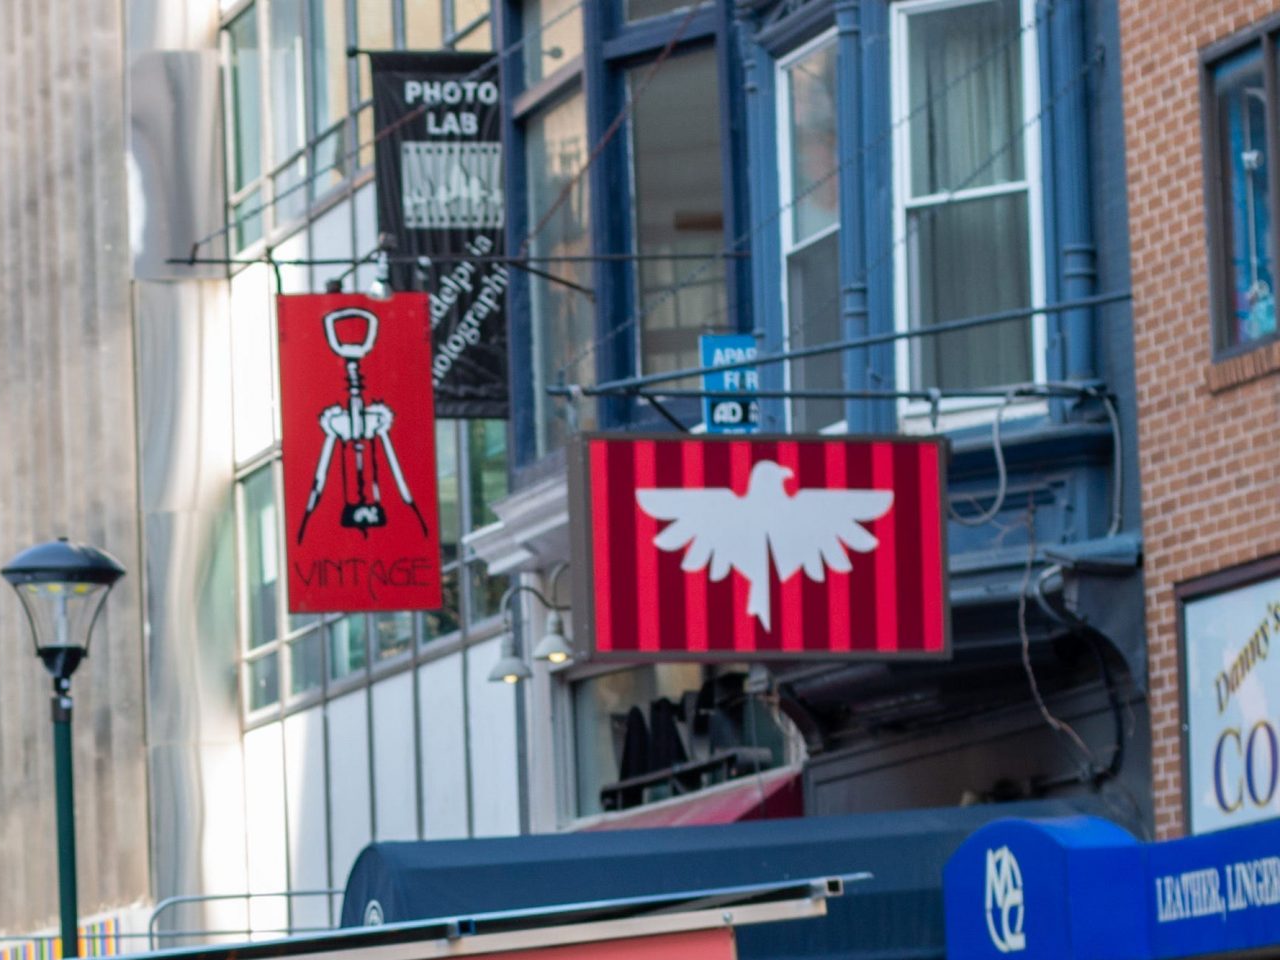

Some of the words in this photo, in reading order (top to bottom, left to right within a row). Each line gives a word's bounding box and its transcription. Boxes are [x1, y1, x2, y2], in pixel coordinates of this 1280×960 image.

[404, 80, 498, 105] PHOTO
[426, 111, 478, 135] LAB
[294, 557, 433, 601] VINTAGE
[1155, 867, 1226, 922] LEATHER,
